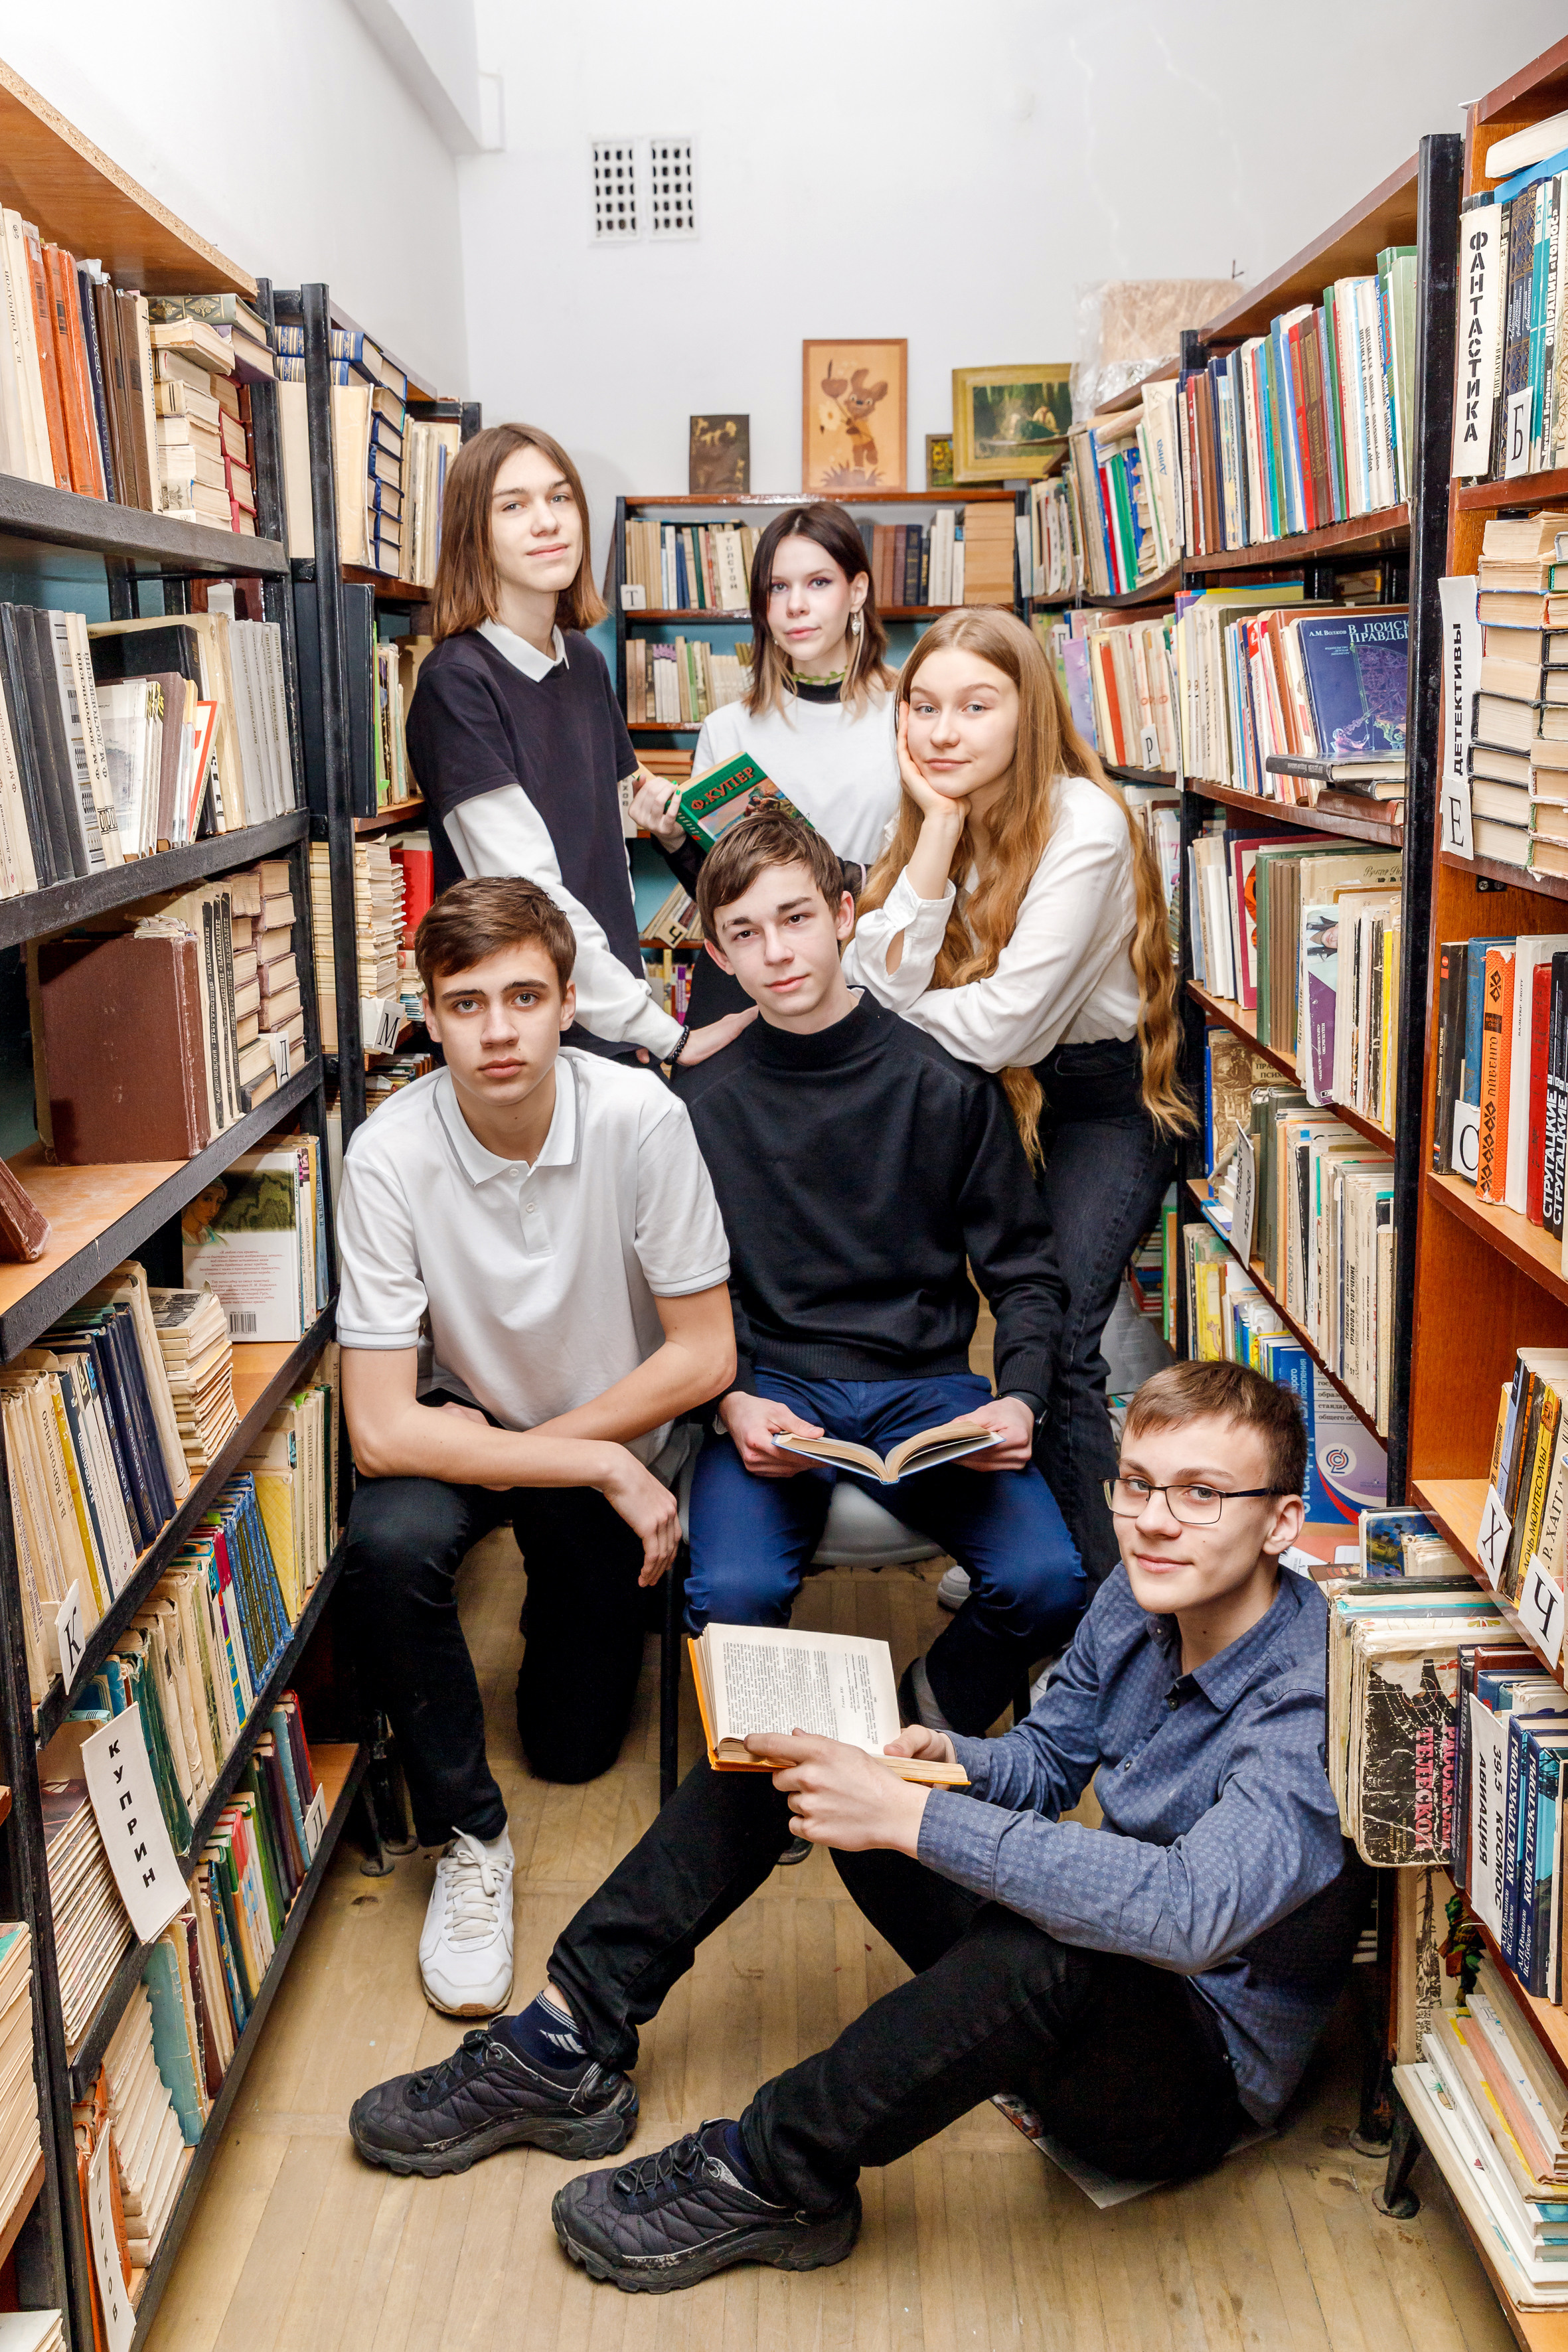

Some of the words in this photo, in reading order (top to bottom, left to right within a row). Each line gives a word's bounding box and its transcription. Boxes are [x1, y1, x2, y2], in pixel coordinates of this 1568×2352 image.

[1549, 209, 1559, 270] «ГОЛОС»
[4, 270, 16, 333] ГОНЧАРОВ
[1382, 293, 1391, 366] Педагогика
[1545, 272, 1557, 346] ОПЕРАЦИЯ
[87, 287, 102, 384] ОБЛОМОВ
[1463, 231, 1488, 443] ФАНТАСТИКА
[99, 400, 112, 479] ГОНЧАРОВ
[1511, 403, 1525, 461] Б
[625, 591, 640, 607] Т
[1348, 625, 1356, 634] В
[1364, 619, 1409, 633] ПОИСК
[76, 653, 95, 747] ДОСТОЕВСКИЙ
[84, 652, 104, 746] ДОСТОЕВСКИЙ
[1452, 622, 1464, 777] ДЕТЕКТИВЫ
[1146, 736, 1153, 764] Р
[1448, 796, 1464, 848] Е
[214, 919, 223, 967] НАКАЗАНИЕ
[222, 917, 231, 964] НАКАЗАНИЕ
[668, 925, 682, 944] Ч
[208, 981, 216, 1044] ПРЕСТУПЛЕНИЕ
[377, 1012, 401, 1049] М
[279, 1039, 289, 1086] Д
[1486, 1036, 1498, 1097] АЙВЕНГО
[1460, 1125, 1479, 1171] С
[1543, 1090, 1557, 1219] СТРУГАЦКИЕ
[1553, 1091, 1568, 1226] СТРУГАЦКИЕ
[41, 1410, 62, 1494] КОРОЛЕНКО
[76, 1433, 93, 1488] КОРОЛЕНКО
[114, 1439, 127, 1487] КОРОЛЕНКО
[127, 1427, 142, 1476] КОРОЛЕНКО
[1492, 1422, 1503, 1470] СОЛОМОНА
[103, 1481, 116, 1512] ПОВЕСТИ
[1528, 1447, 1547, 1536] МОНТЕСУМЫ
[1482, 1503, 1504, 1570] Х
[1524, 1537, 1535, 1571] ДОЧЬ
[1534, 1571, 1558, 1642] Ч
[64, 1606, 82, 1676] К
[1415, 1727, 1434, 1851] ТЕЛЕСКОП
[1442, 1725, 1456, 1851] РАССКАЗАЛ
[1493, 1745, 1503, 1794] 39.5
[108, 1739, 156, 1889] КУПРИН
[313, 1802, 324, 1848] Л
[1478, 1751, 1488, 1867] АВИАЦИЯ
[1506, 1734, 1519, 1887] КОНСТРУКТОРЫ
[1523, 1752, 1537, 1907] КОНСТРУКТОРЫ
[1494, 1810, 1504, 1911] КОСМОС
[95, 2165, 118, 2323] ЛЕСКОВ
